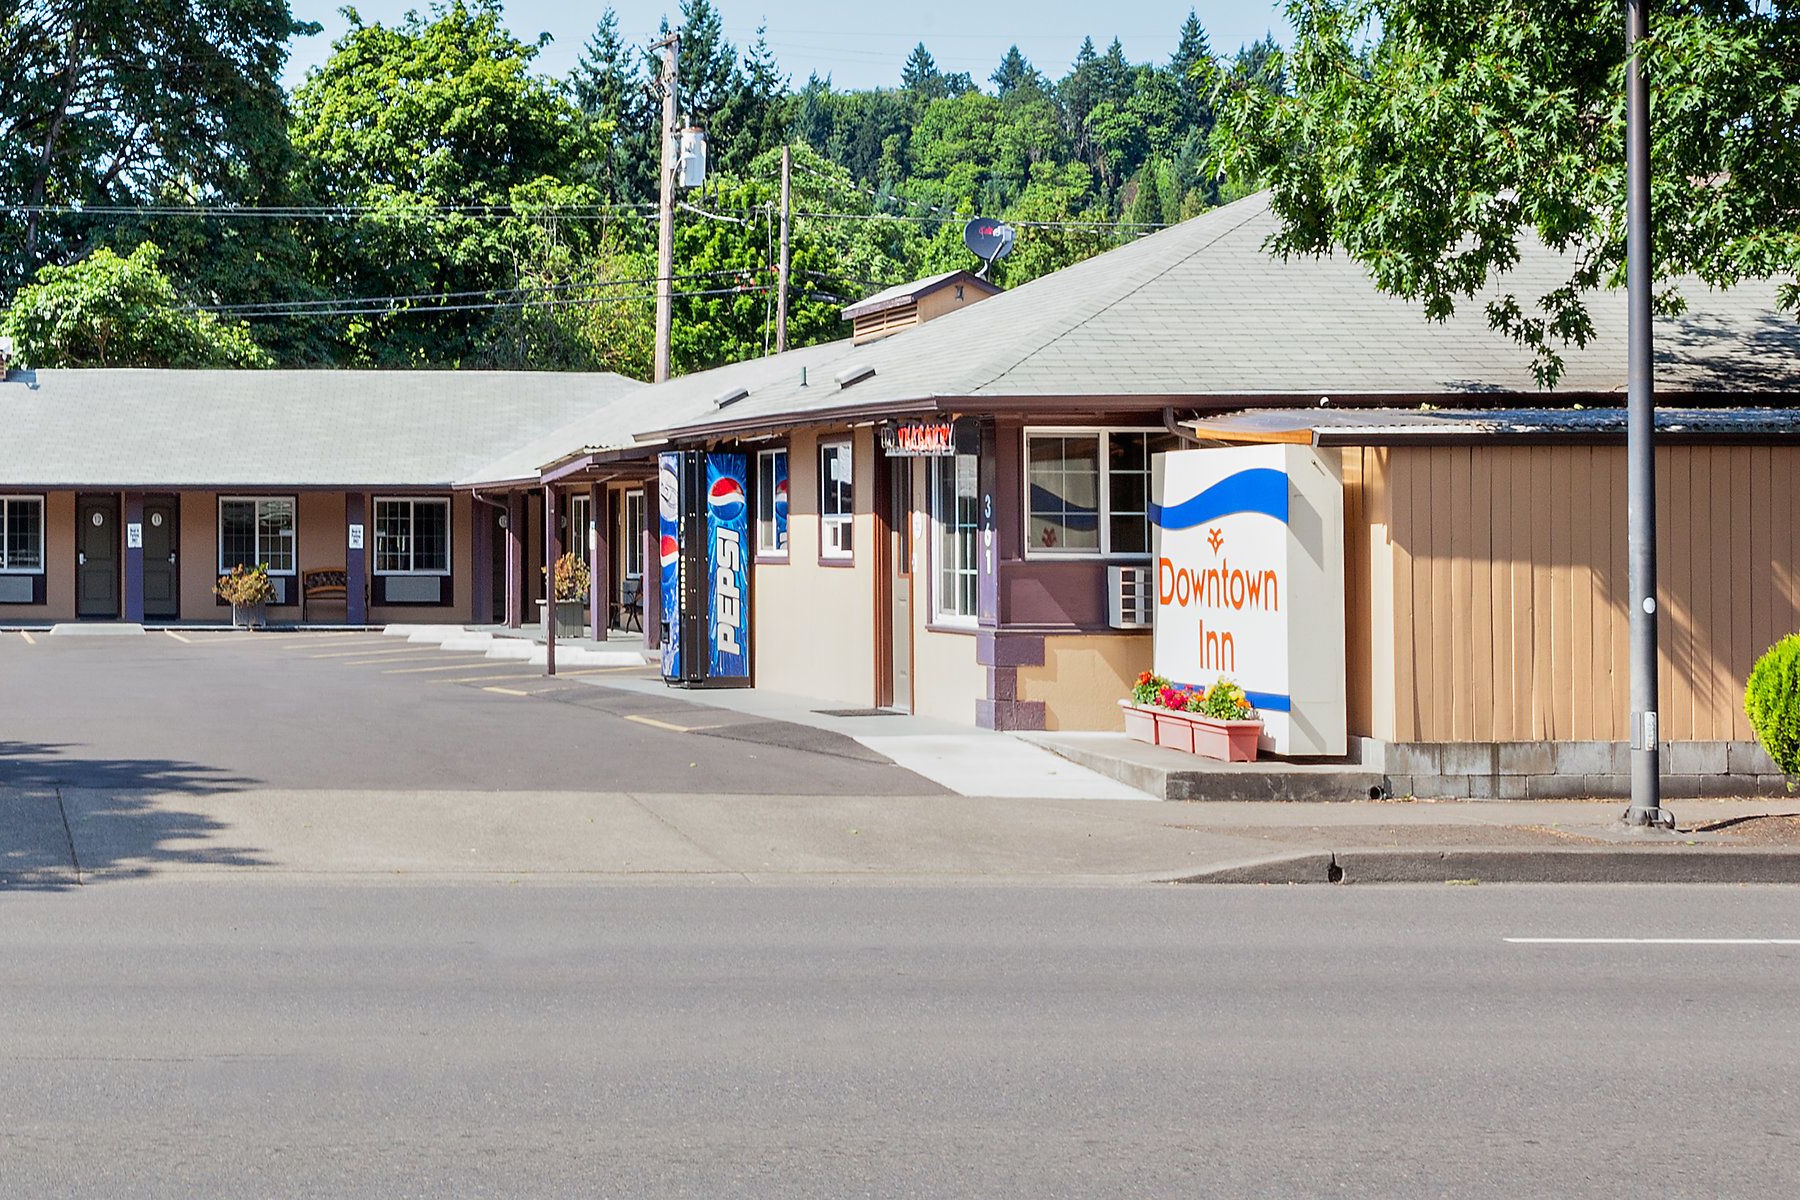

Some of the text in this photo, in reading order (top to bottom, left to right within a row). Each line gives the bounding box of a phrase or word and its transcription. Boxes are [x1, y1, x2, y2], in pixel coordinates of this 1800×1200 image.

[984, 494, 992, 575] 361
[716, 526, 740, 656] PEPSI
[1158, 557, 1278, 611] Downtown
[1199, 619, 1234, 672] Inn
